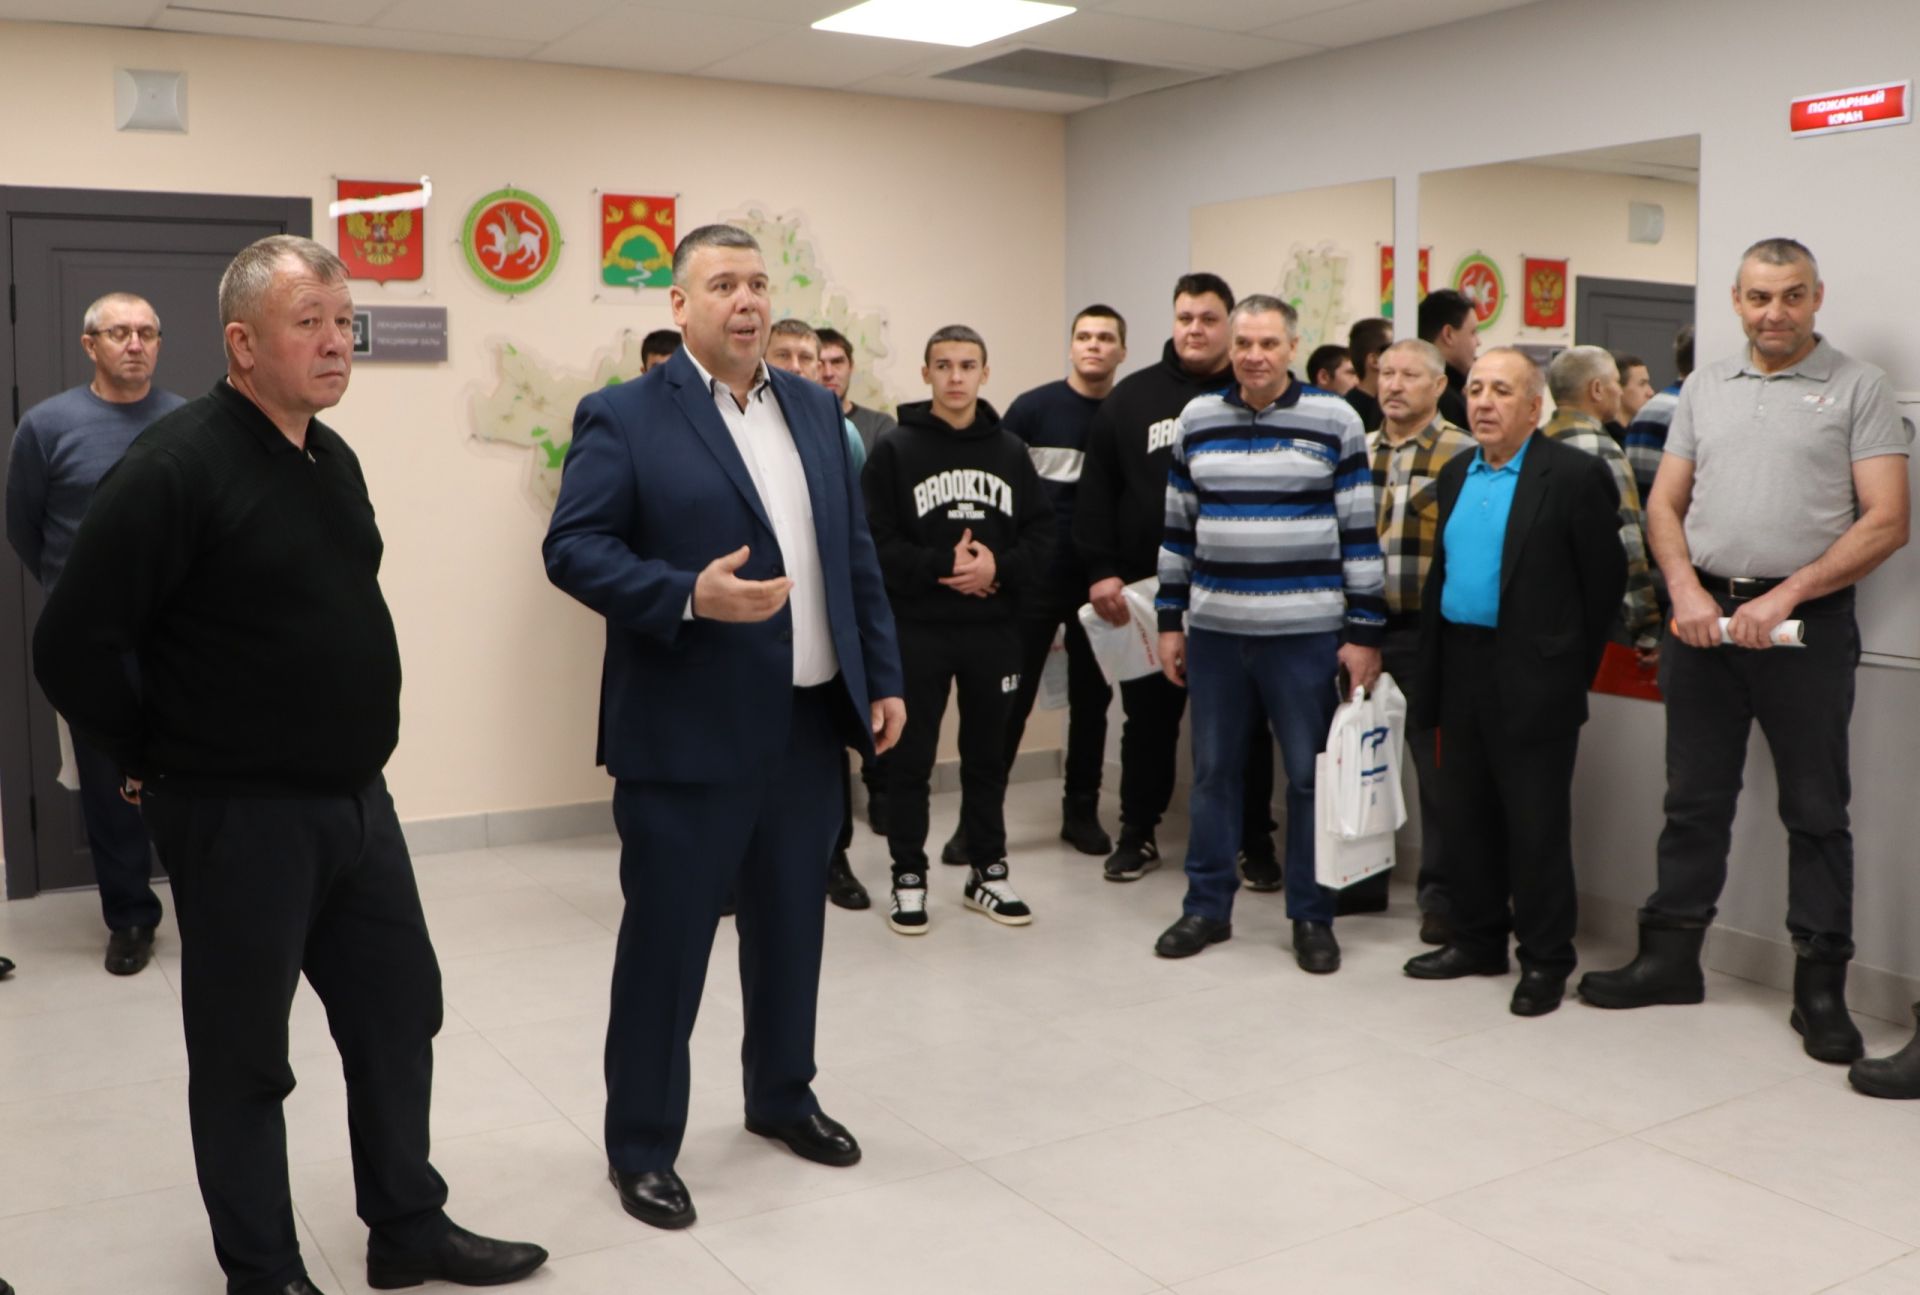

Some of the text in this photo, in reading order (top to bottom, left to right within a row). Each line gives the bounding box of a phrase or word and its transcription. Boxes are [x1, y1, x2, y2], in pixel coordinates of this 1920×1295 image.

[1806, 89, 1886, 115] ПОЖАРНЫЙ
[1827, 110, 1864, 125] КРАН
[913, 468, 1013, 519] BROOKLYN
